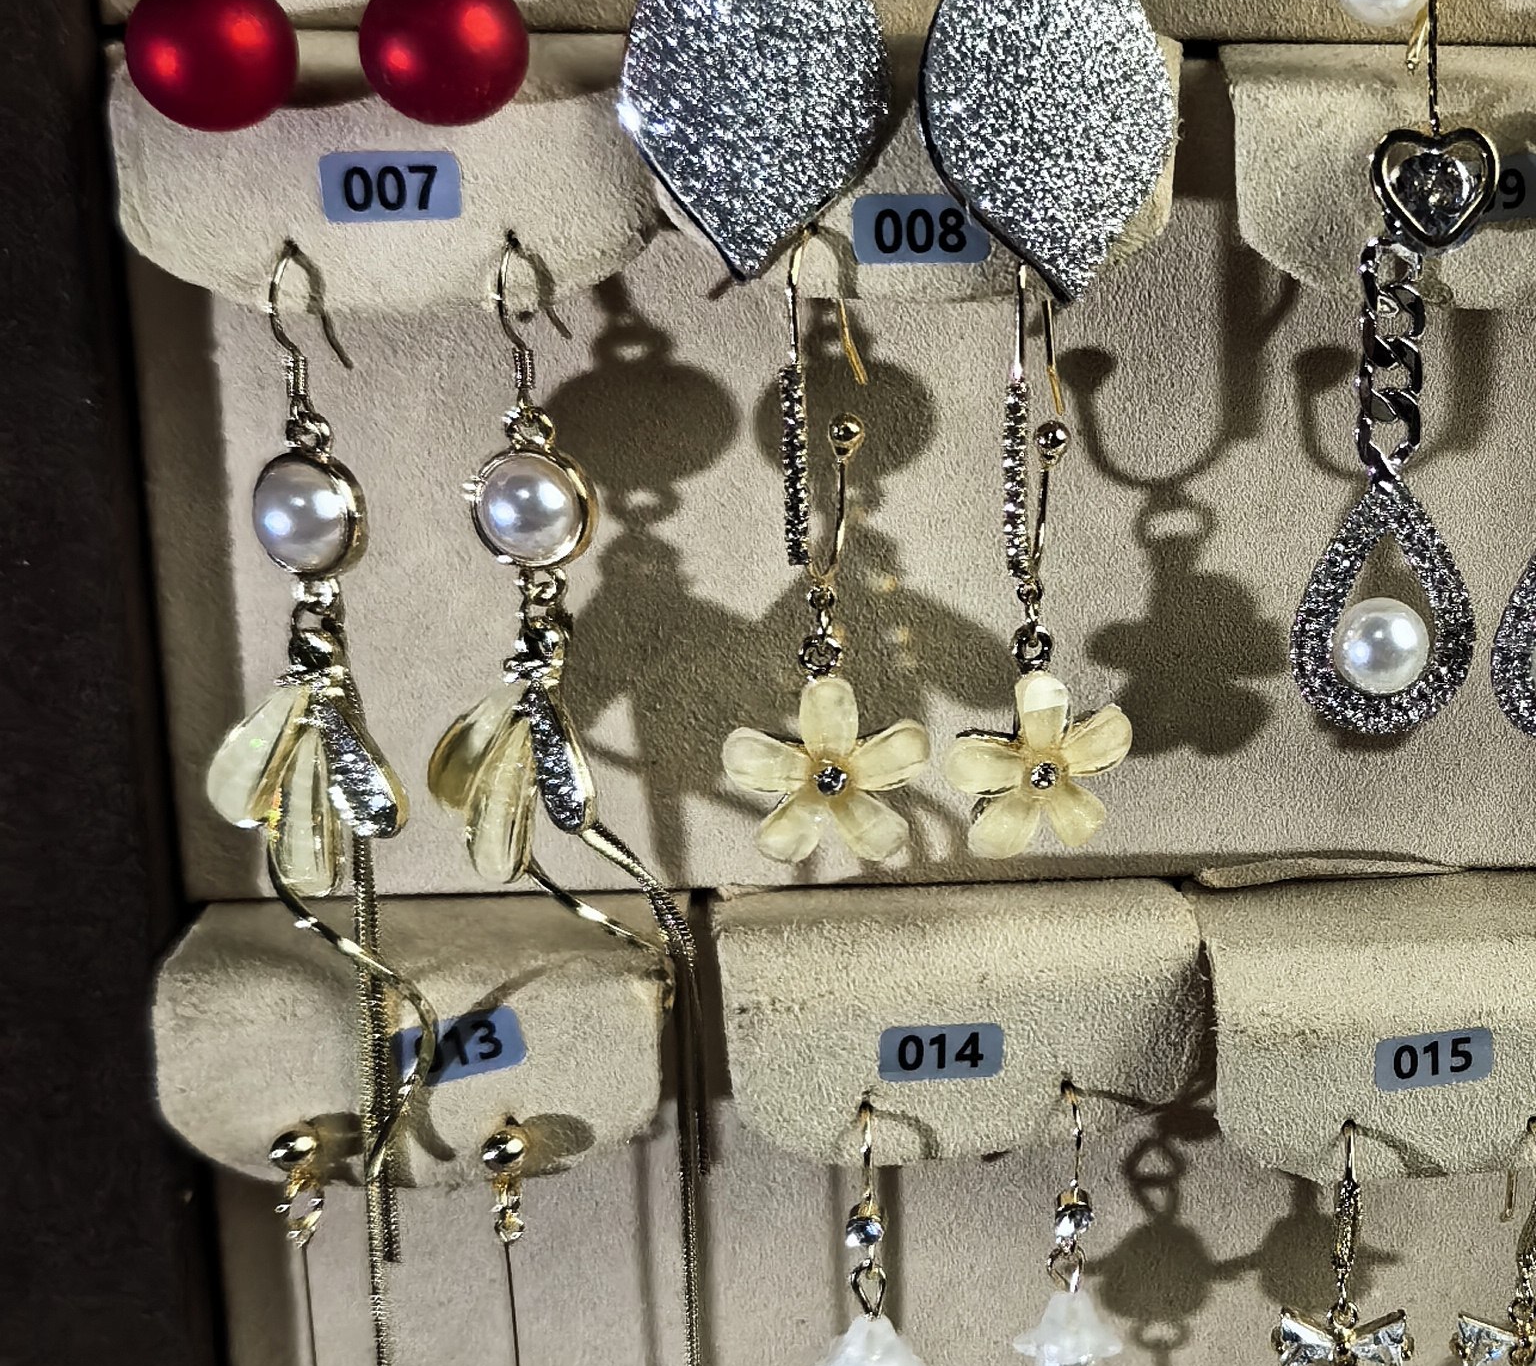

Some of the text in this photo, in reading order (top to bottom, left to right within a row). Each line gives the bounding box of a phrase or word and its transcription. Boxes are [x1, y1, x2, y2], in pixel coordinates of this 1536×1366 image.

[342, 164, 438, 212] 007
[873, 206, 967, 254] 008
[897, 1031, 985, 1072] 014
[1393, 1036, 1473, 1080] 015
